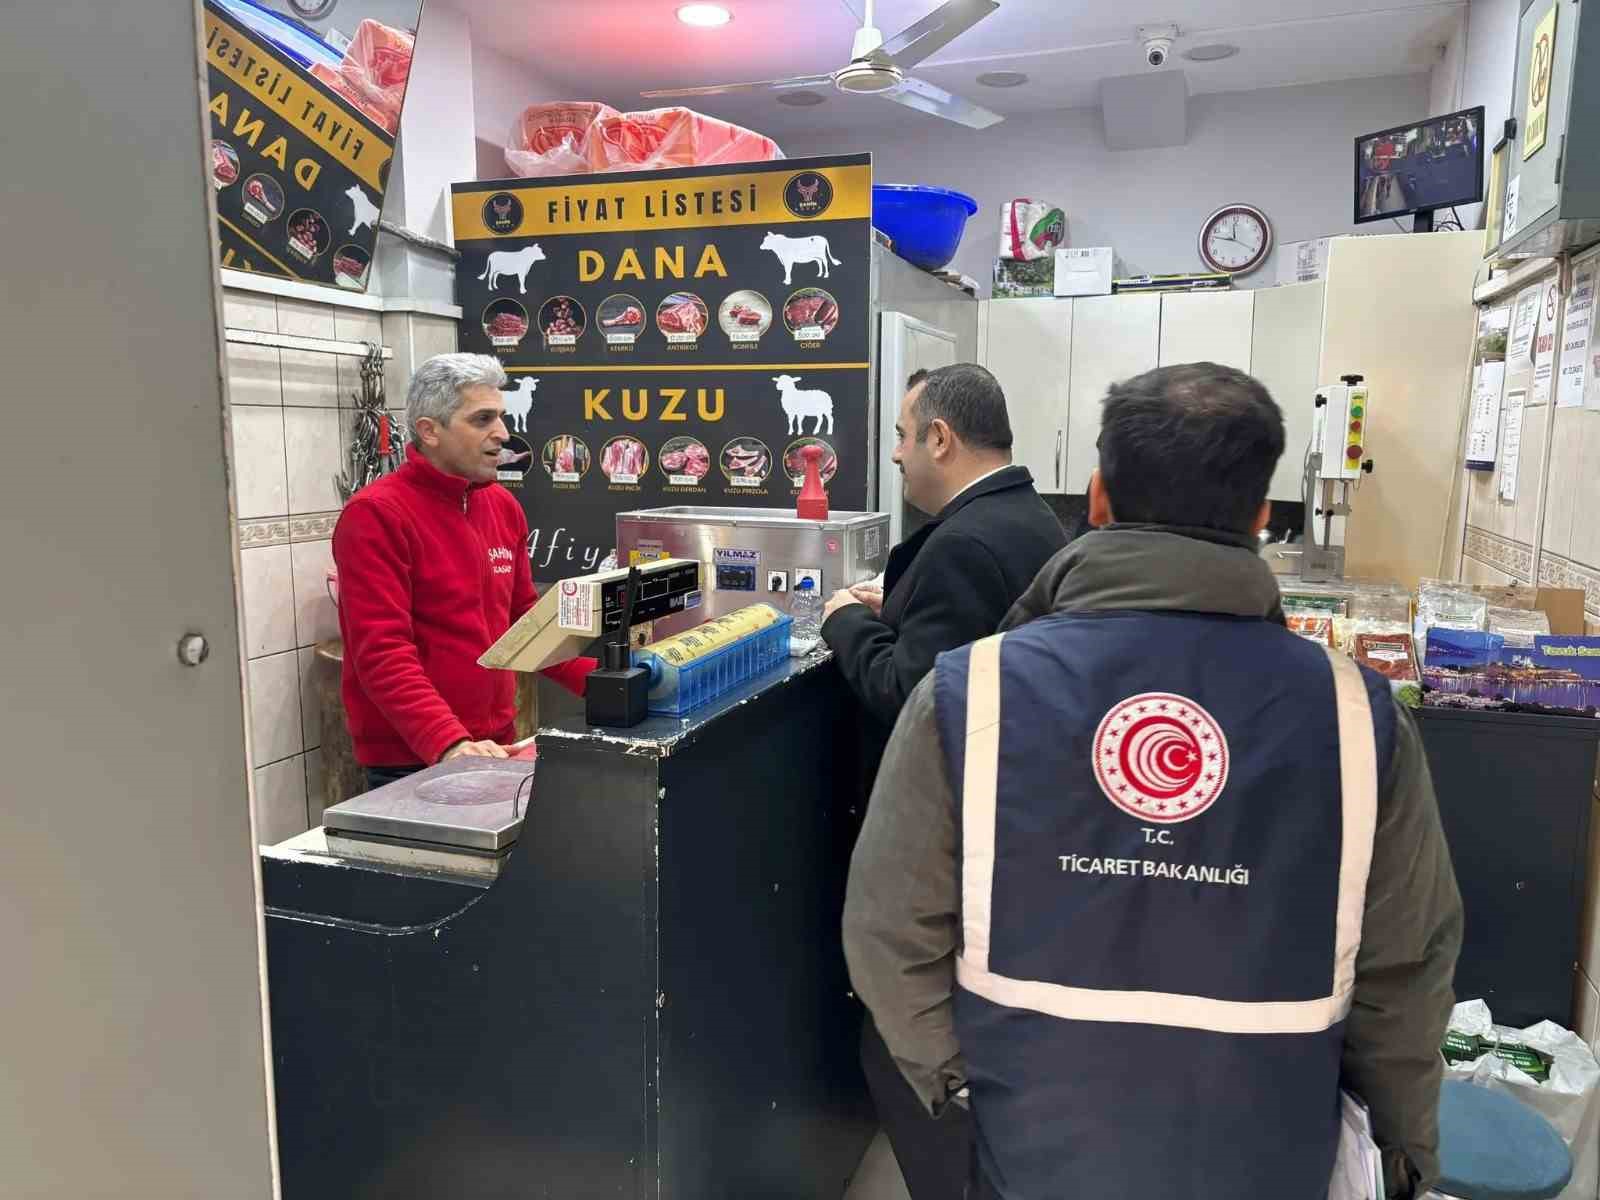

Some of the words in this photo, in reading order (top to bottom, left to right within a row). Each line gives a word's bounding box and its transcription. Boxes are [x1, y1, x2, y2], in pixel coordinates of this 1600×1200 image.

[548, 196, 625, 223] FİYAT
[645, 184, 756, 218] LİSTESİ
[578, 244, 728, 282] DANA
[584, 388, 725, 421] KUZU
[1140, 827, 1175, 845] T.C.
[1058, 854, 1141, 876] TİCARET
[1142, 861, 1250, 885] BAKANLIĞI
